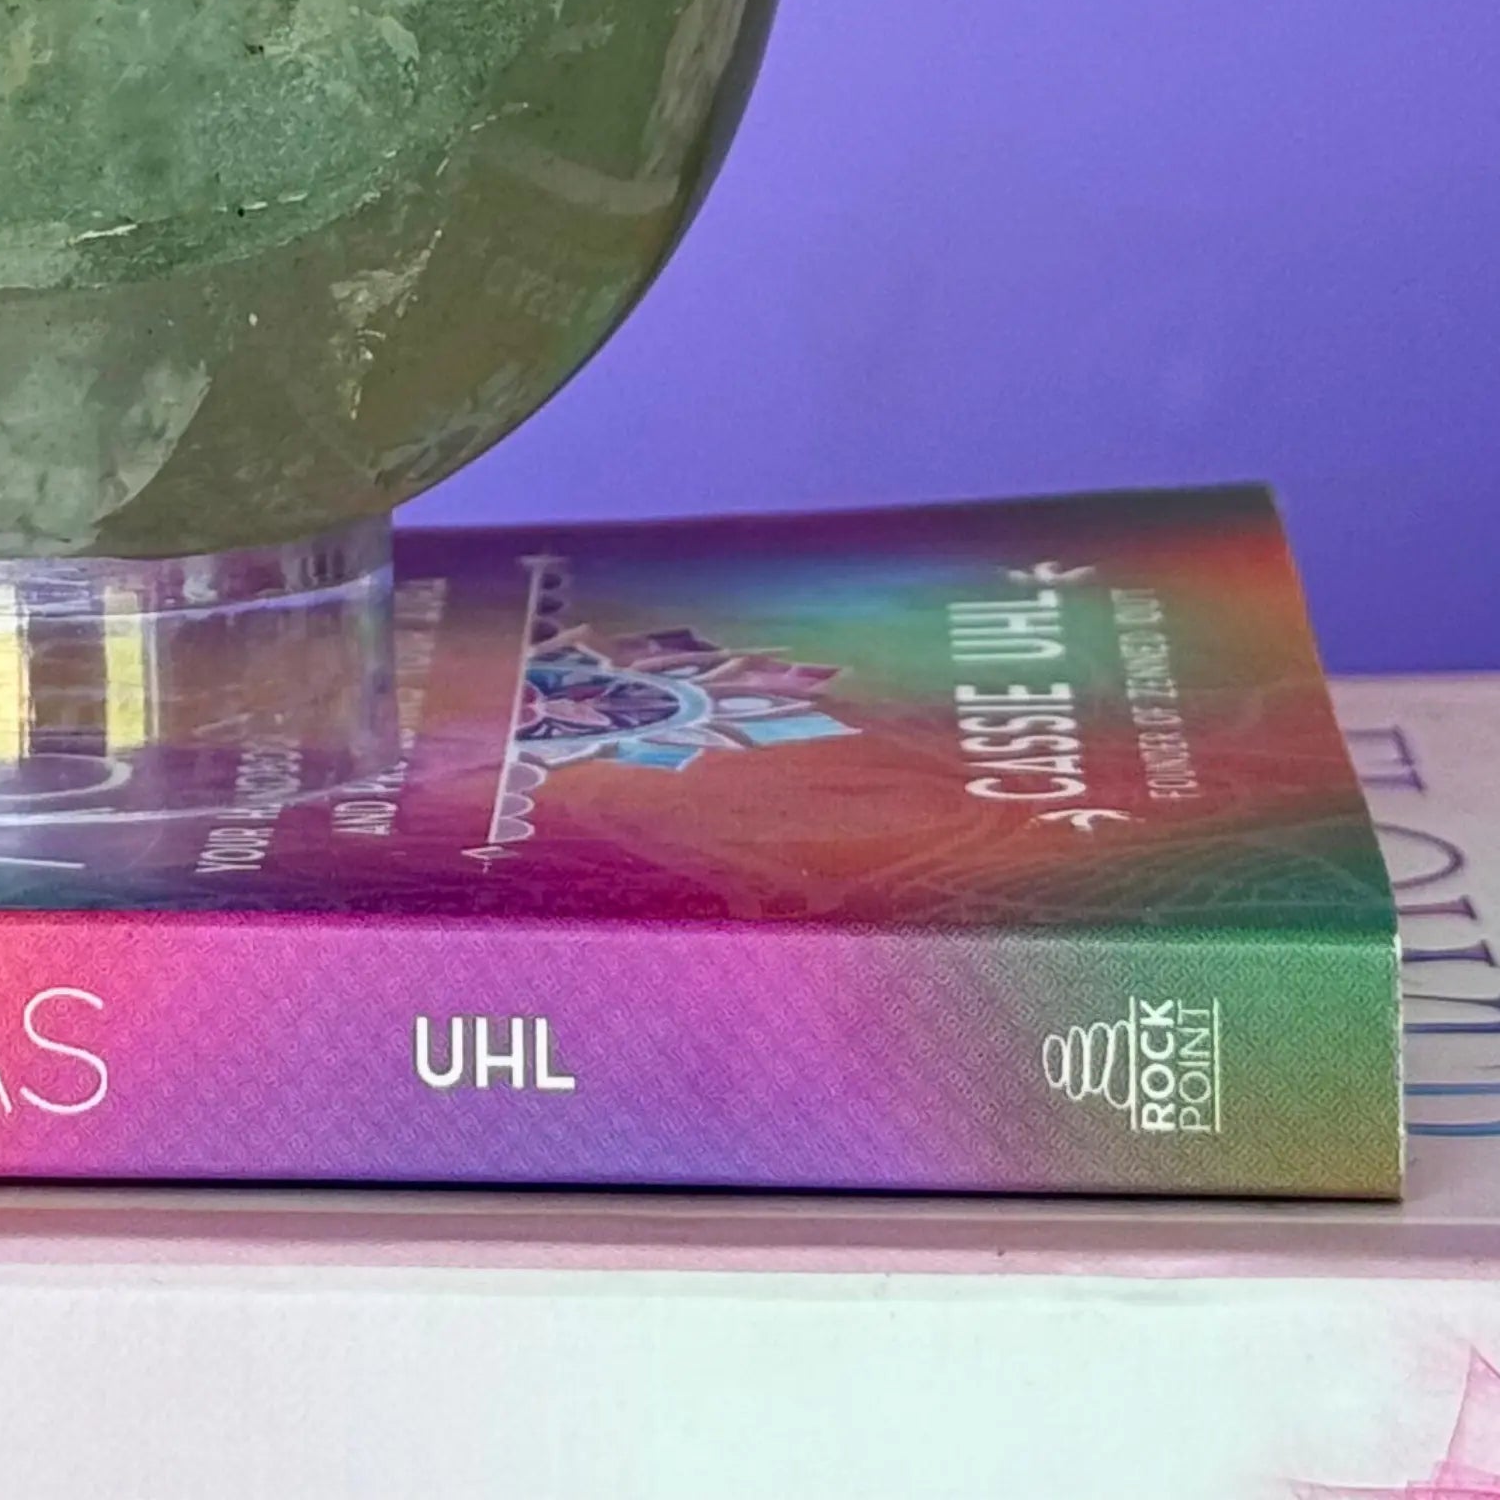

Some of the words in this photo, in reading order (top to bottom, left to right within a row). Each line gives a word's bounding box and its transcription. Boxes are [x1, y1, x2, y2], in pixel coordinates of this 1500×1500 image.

[945, 588, 1066, 661] UHL
[1109, 587, 1164, 625] OUT
[1118, 631, 1179, 700] ZENNED
[954, 682, 1087, 800] CASSIE
[1130, 705, 1183, 726] OF
[1137, 731, 1201, 800] FOUNDER
[195, 827, 275, 873] YOUR
[331, 799, 398, 836] AND
[414, 1016, 577, 1091] UHL
[1140, 999, 1177, 1132] ROCK
[1179, 1002, 1212, 1133] POINT
